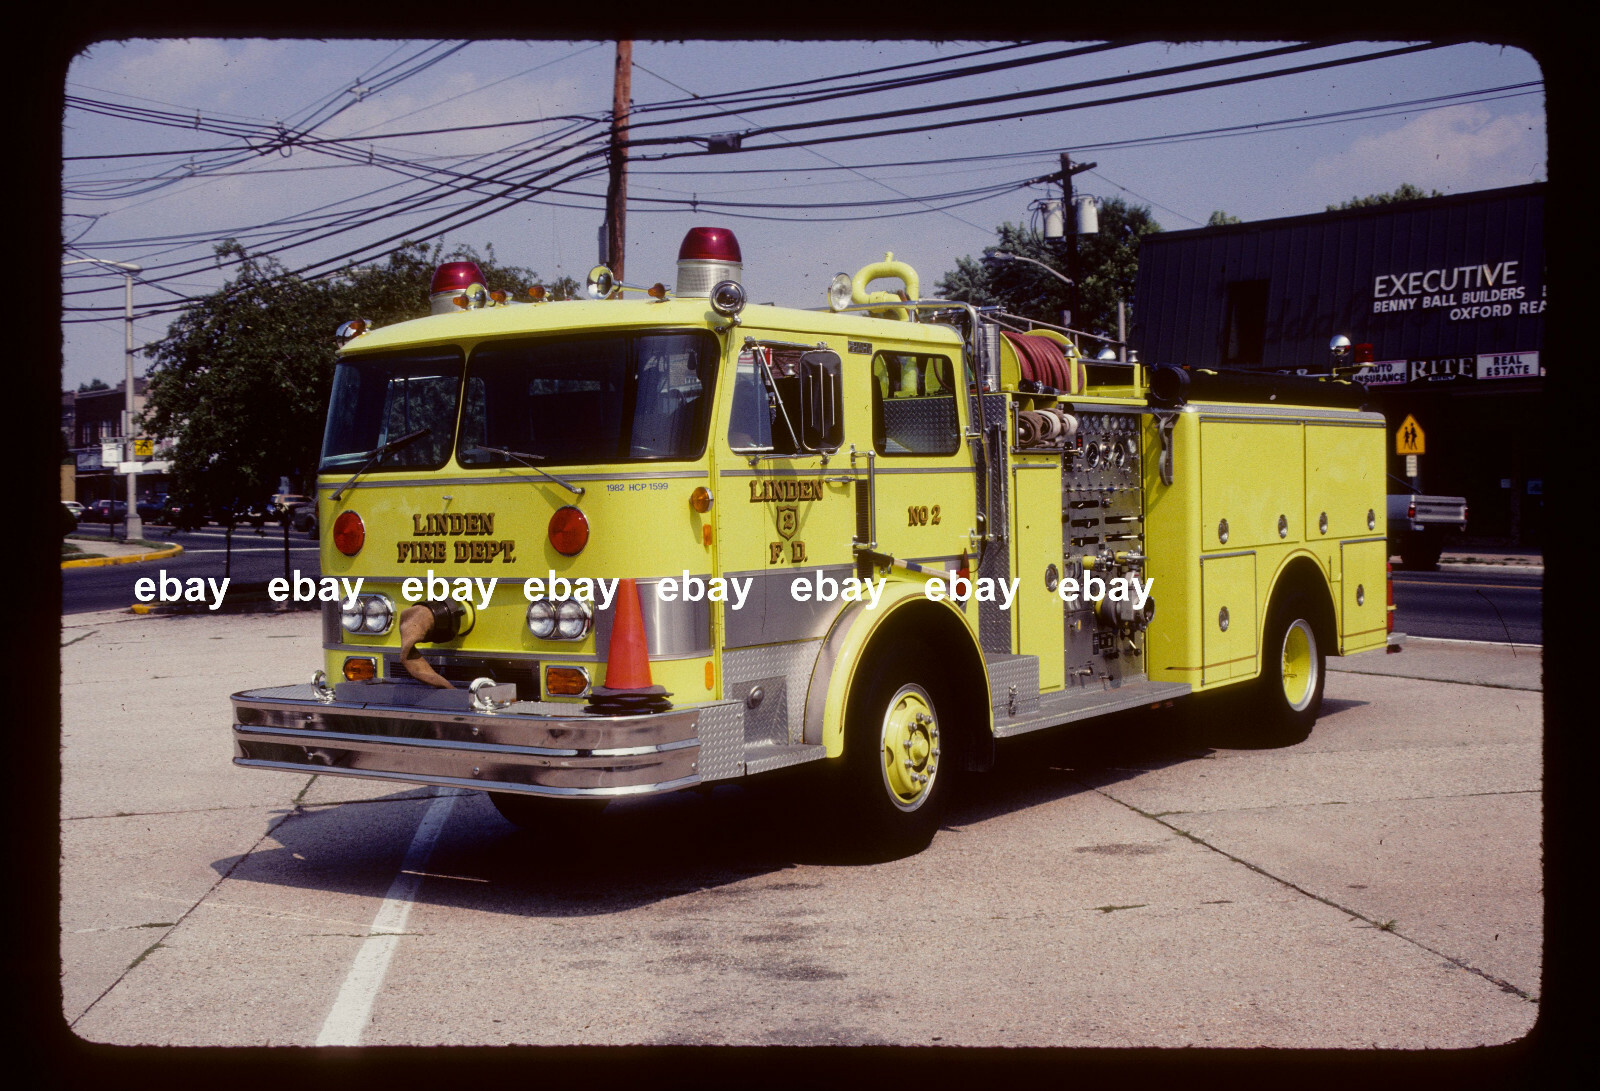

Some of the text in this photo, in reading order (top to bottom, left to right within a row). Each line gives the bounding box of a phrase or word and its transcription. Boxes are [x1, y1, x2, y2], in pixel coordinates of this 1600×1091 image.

[1374, 261, 1519, 298] EXECUTIVE
[1373, 297, 1417, 313] BENNY
[1422, 294, 1457, 309] BALL
[1462, 287, 1526, 304] BUILDERS
[1450, 304, 1513, 321] OXFORD
[1368, 364, 1393, 374] AUTO
[1410, 357, 1474, 383] RITE
[1486, 365, 1530, 377] ESTATE
[1493, 355, 1522, 366] REAL
[606, 482, 669, 492] 1982 HCP 1599
[749, 479, 824, 503] LINDEN
[412, 512, 496, 537] LINDEN
[782, 513, 795, 530] 2
[908, 504, 942, 526] NO 2
[397, 540, 517, 564] FIRE DEPT.
[769, 540, 809, 565] F. D.
